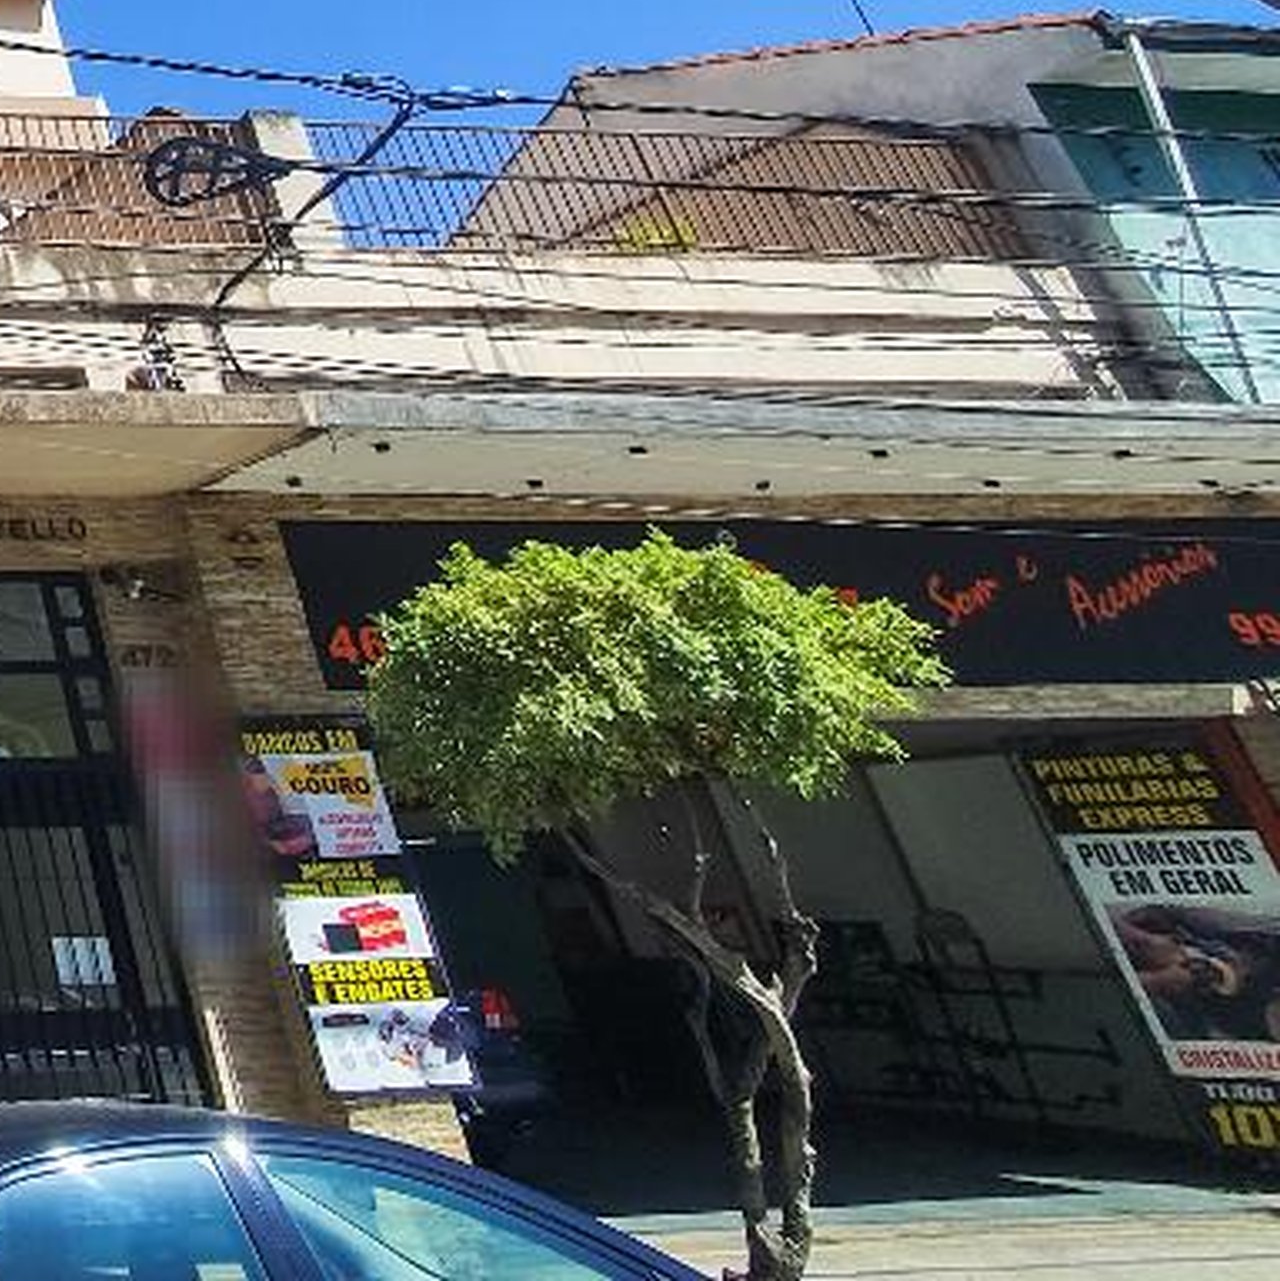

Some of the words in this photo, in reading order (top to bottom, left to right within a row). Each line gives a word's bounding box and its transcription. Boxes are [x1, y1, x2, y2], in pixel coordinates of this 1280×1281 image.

[1032, 753, 1175, 781] PINTURAS
[289, 776, 372, 795] COURO
[1046, 777, 1220, 804] FUNILARIAS
[1078, 803, 1212, 829] EXPRESS
[1074, 836, 1256, 868] POLIMENTOS
[1108, 870, 1158, 896] EM
[1160, 868, 1252, 895] GERAL
[308, 960, 427, 983] SENSORES
